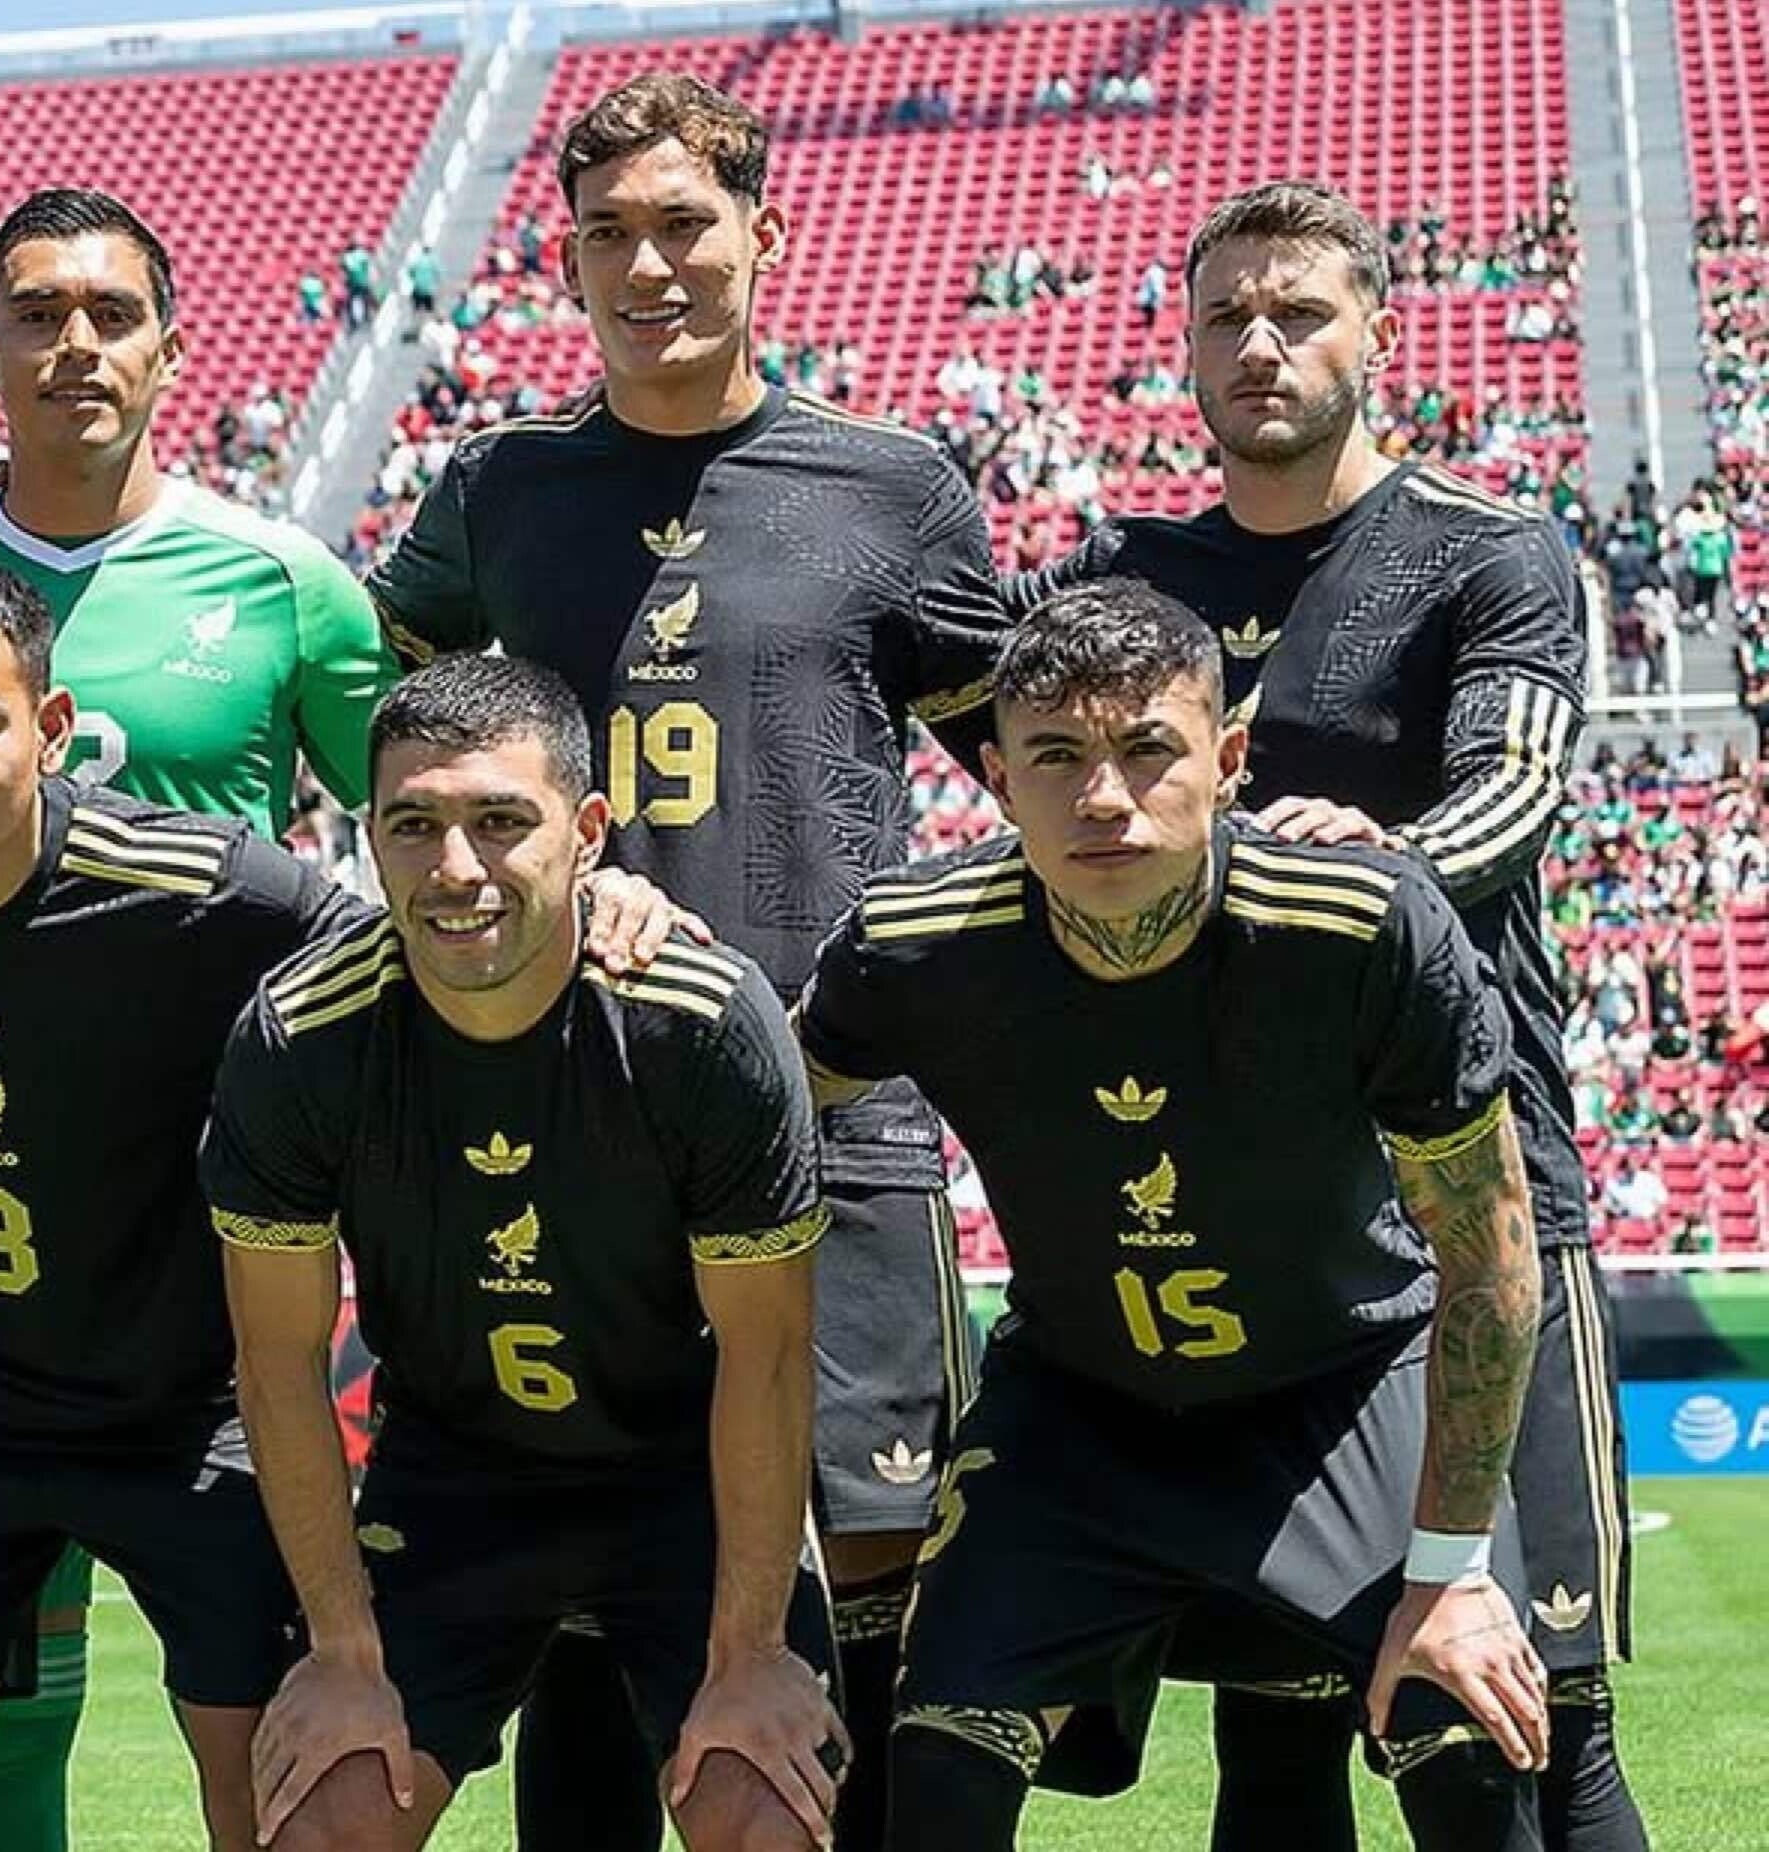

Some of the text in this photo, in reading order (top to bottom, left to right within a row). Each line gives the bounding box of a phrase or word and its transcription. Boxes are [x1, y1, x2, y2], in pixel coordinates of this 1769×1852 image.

[610, 702, 719, 827] 19
[1114, 1267, 1247, 1357] 15
[488, 1323, 578, 1411] 6
